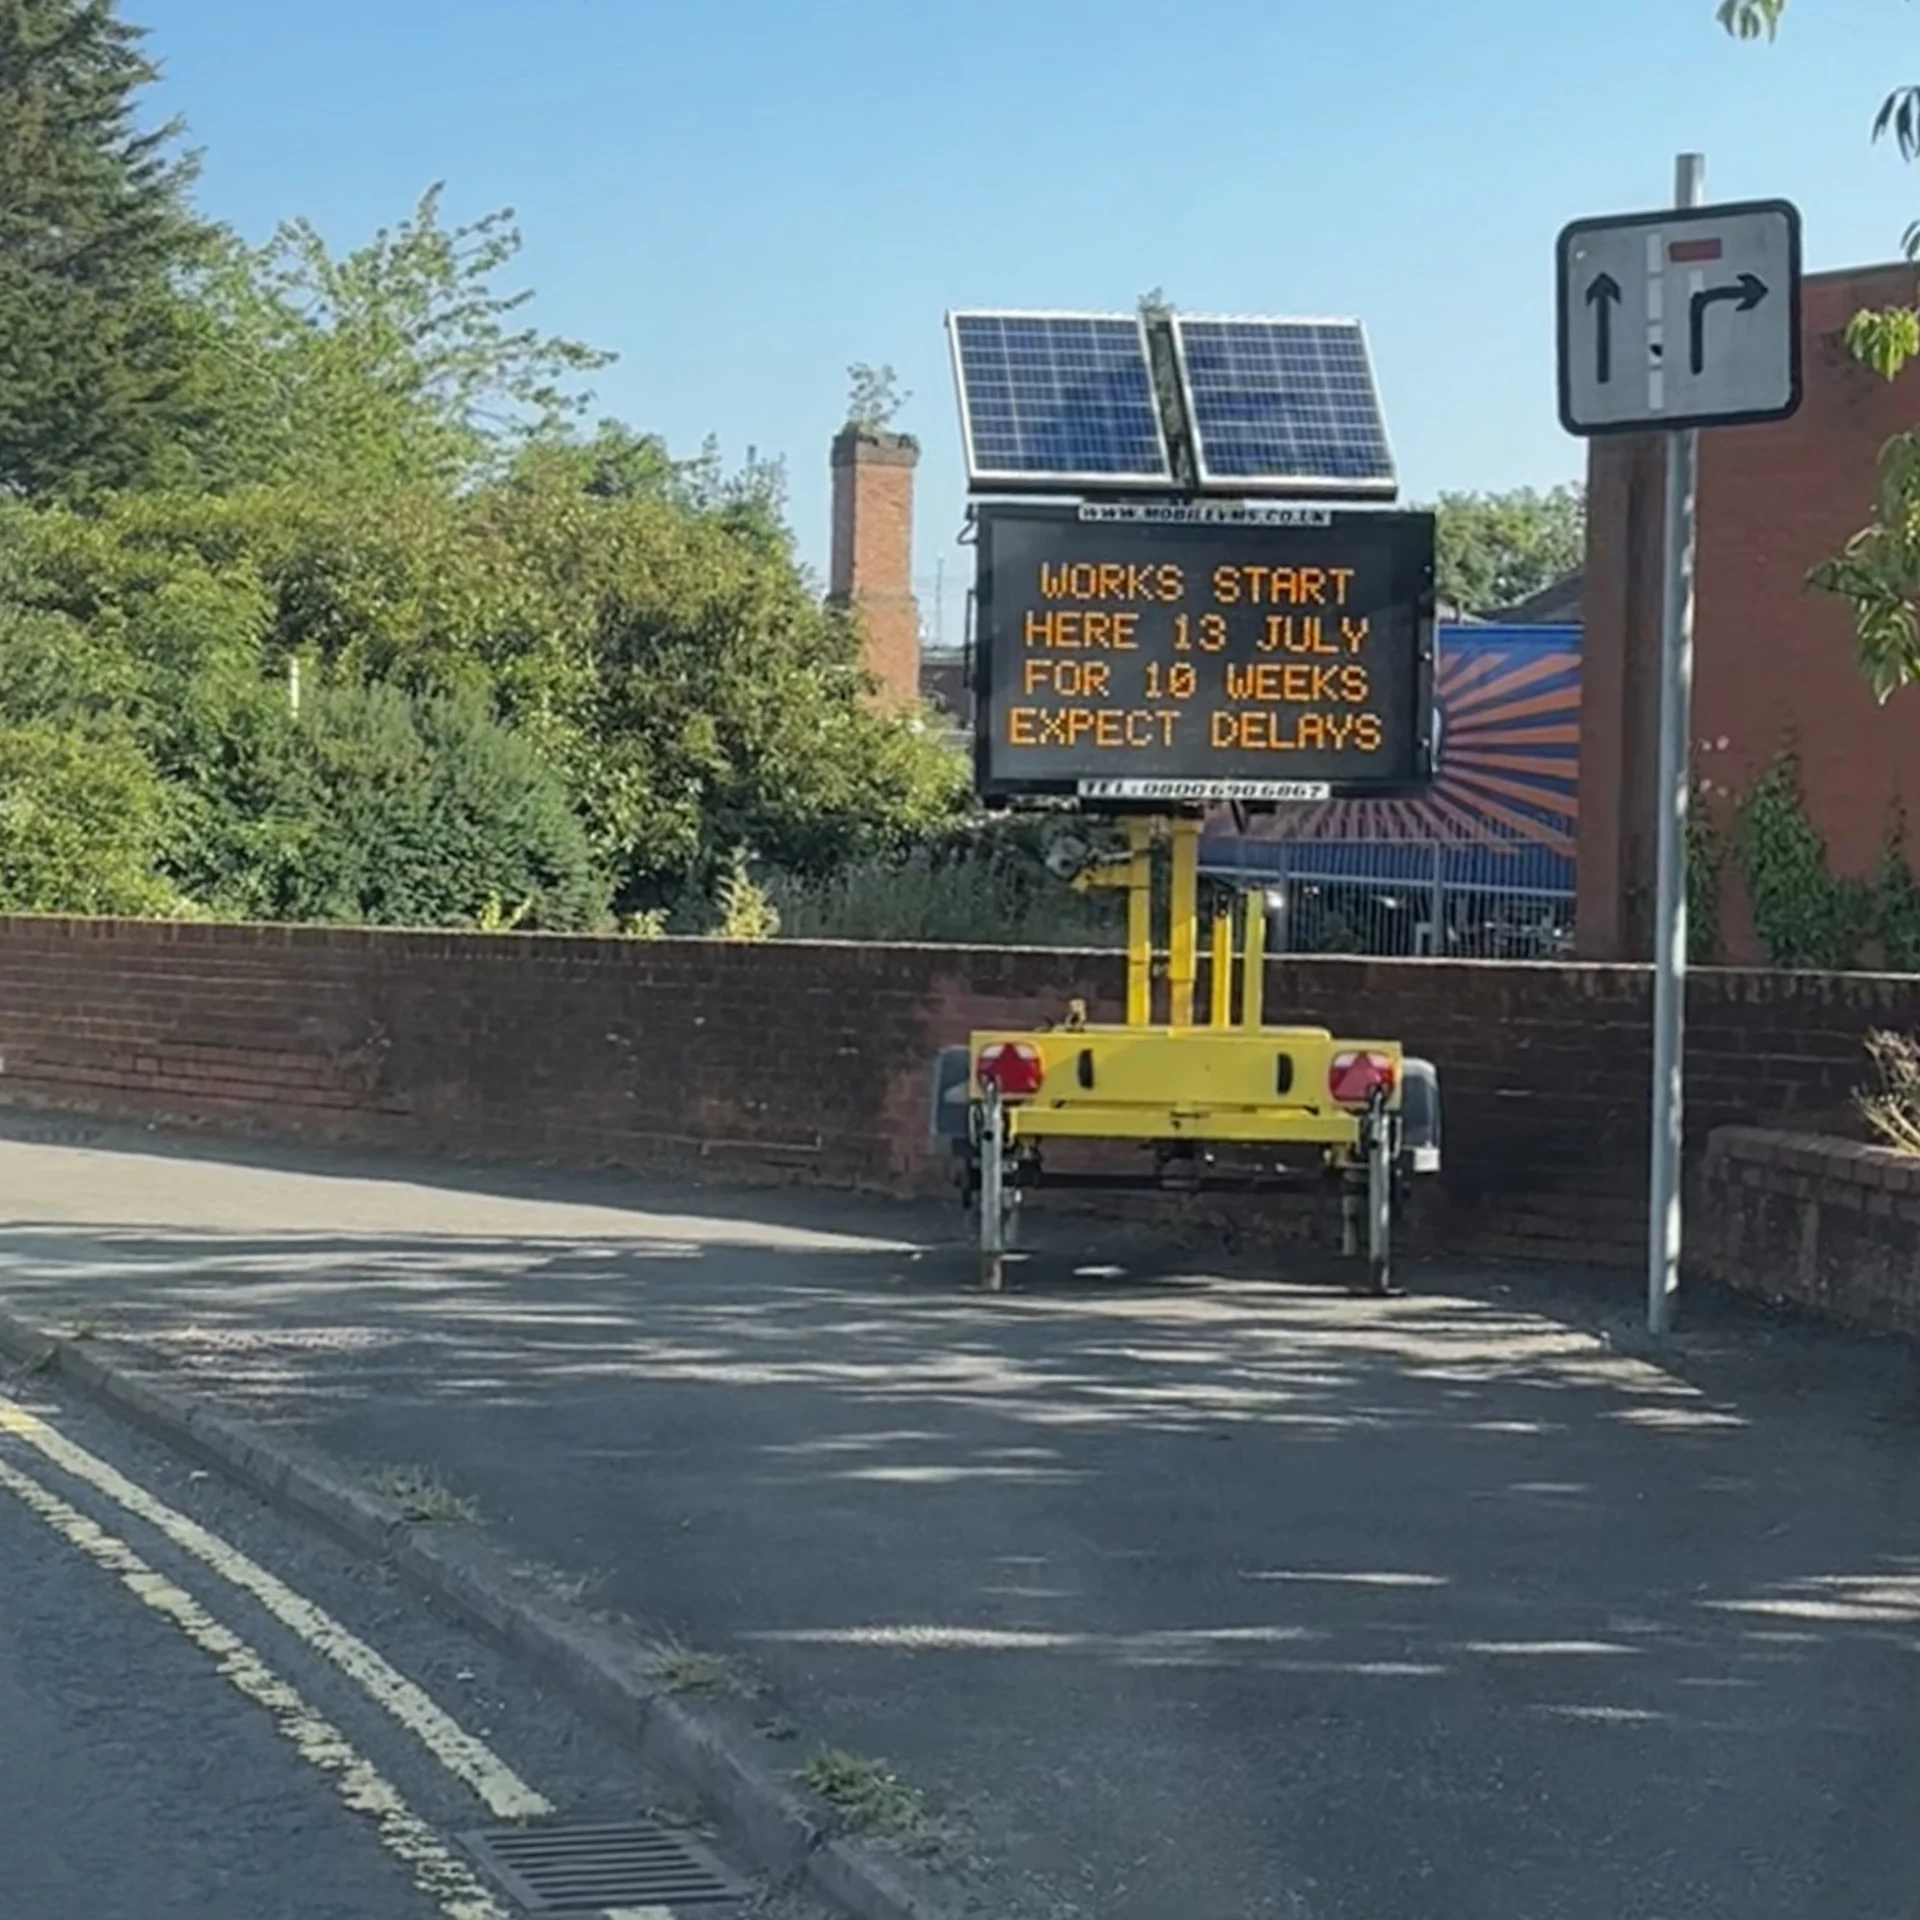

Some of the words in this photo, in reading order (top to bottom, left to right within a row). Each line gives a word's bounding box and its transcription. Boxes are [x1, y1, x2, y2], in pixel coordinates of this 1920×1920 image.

[1040, 563, 1184, 601] WORKS
[1214, 567, 1354, 606] START
[1024, 611, 1139, 649] HERE
[1173, 614, 1226, 651] 13
[1257, 616, 1370, 654] JULY
[1024, 660, 1109, 697] FOR
[1145, 662, 1196, 699] 10
[1227, 663, 1368, 702] WEEKS
[1009, 708, 1182, 747] EXPECT
[1210, 712, 1383, 751] DELAYS
